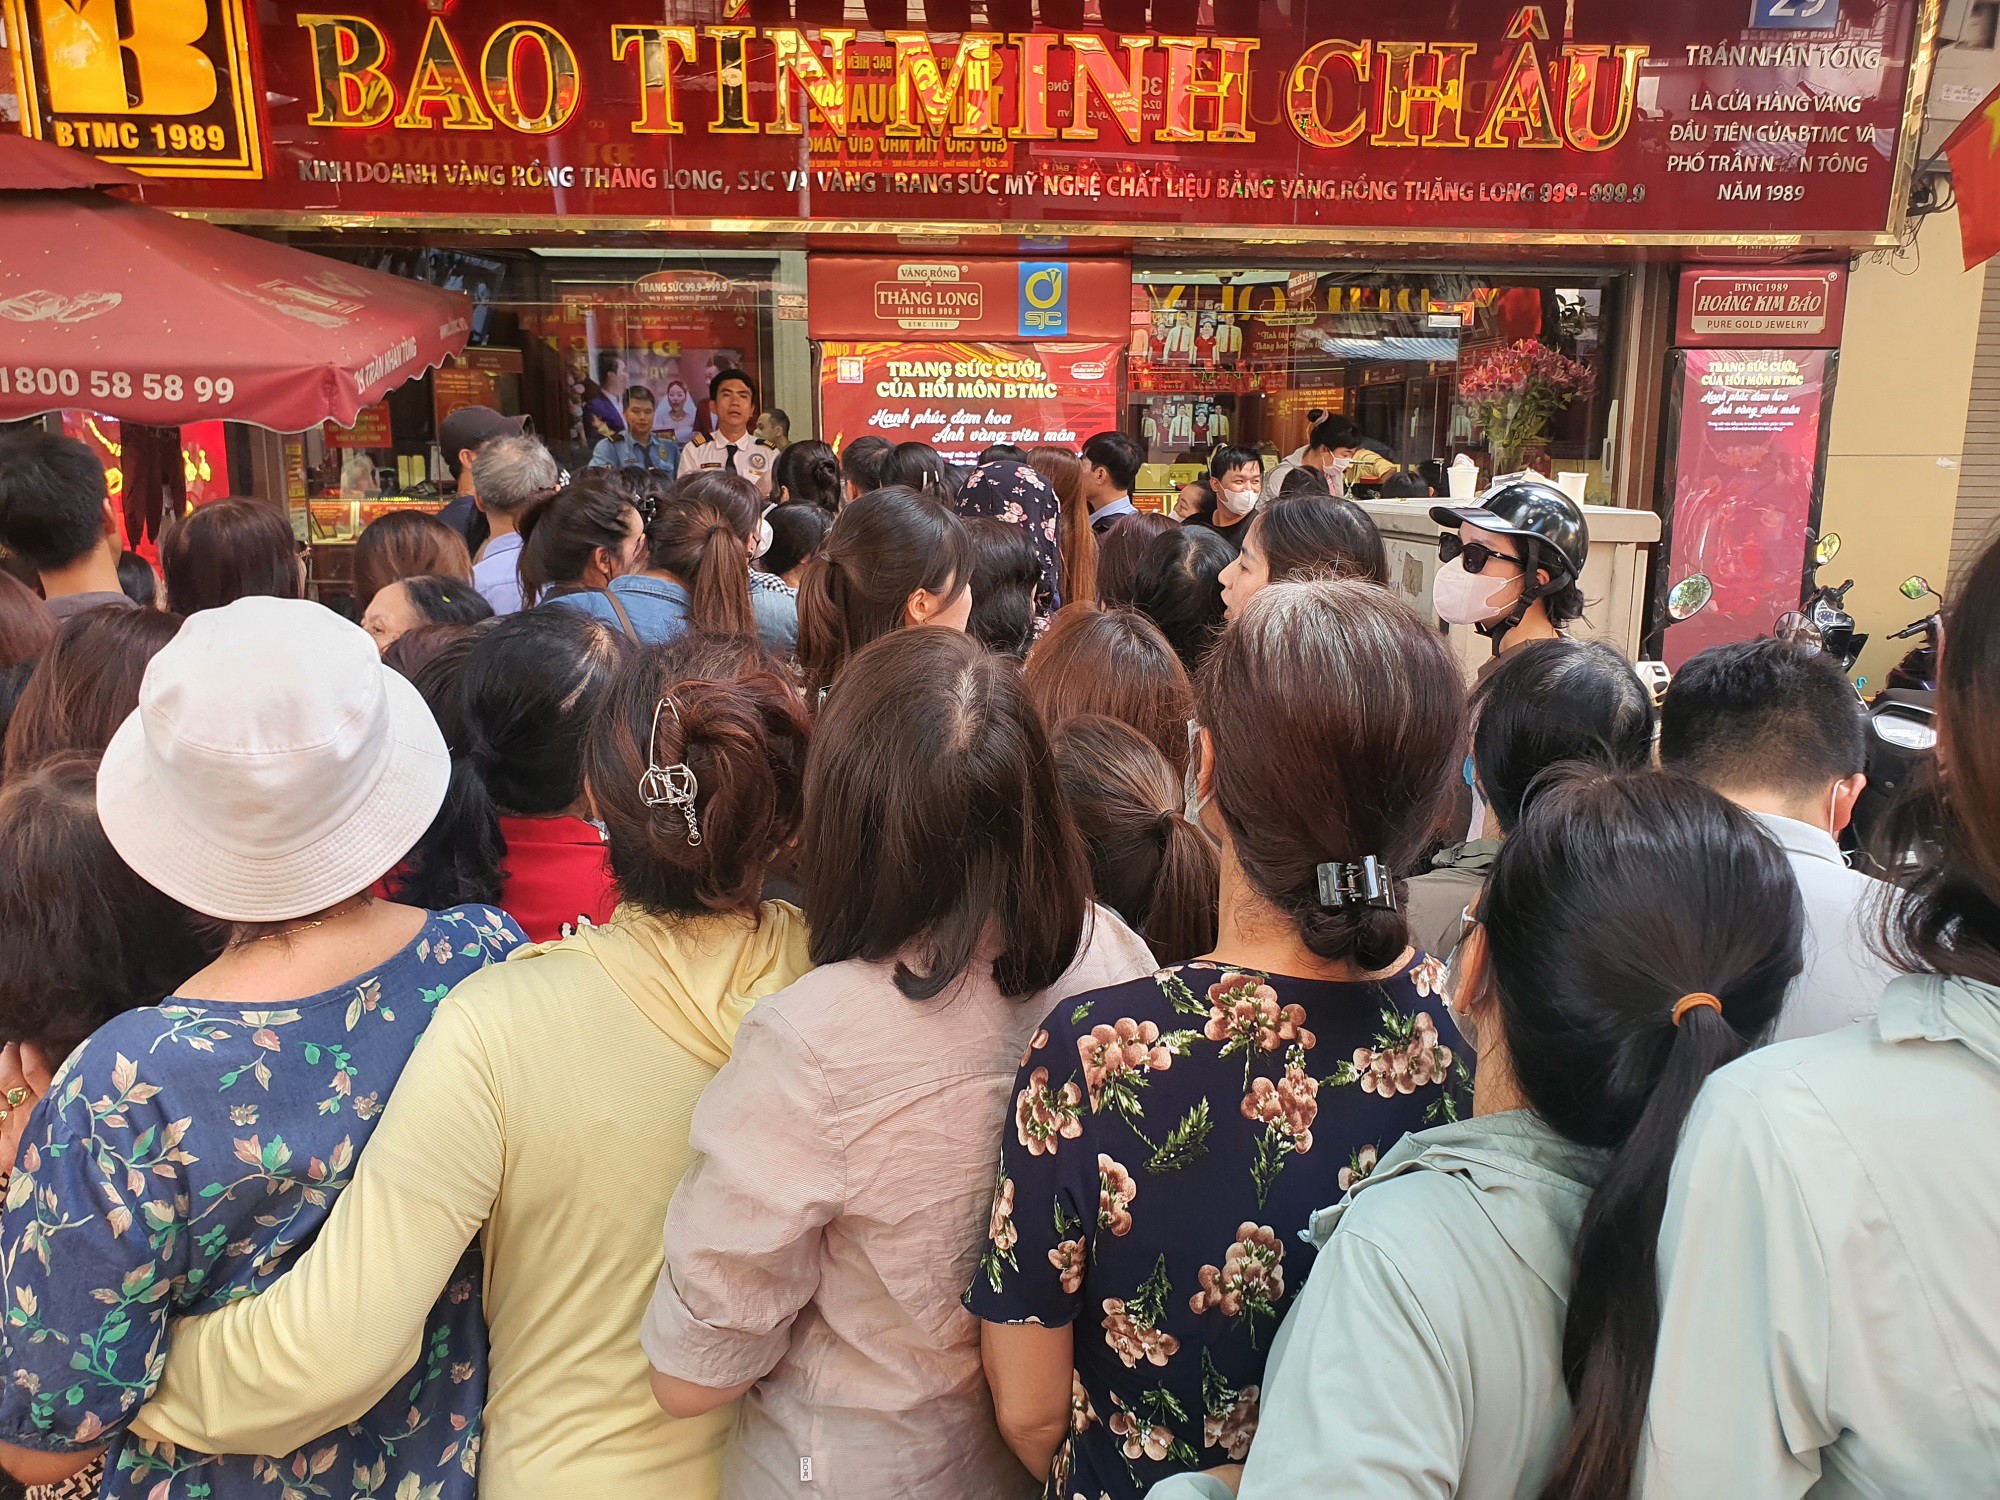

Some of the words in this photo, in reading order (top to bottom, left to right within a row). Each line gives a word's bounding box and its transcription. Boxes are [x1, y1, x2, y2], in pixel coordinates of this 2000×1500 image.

[611, 0, 856, 138] TÍN
[884, 30, 1261, 144] MINH
[1286, 5, 1650, 152] CHÂU
[1691, 91, 1712, 111] LÀ
[1717, 89, 1750, 111] CỬA
[1756, 91, 1809, 112] HÀNG
[54, 121, 139, 149] BTMC
[151, 123, 225, 151] 1989
[1670, 119, 1707, 142] ĐẦU
[1714, 123, 1751, 142] TIÊN
[1756, 121, 1792, 142] CỦA
[1797, 126, 1849, 143] BTMC
[1856, 123, 1876, 143] VÀ
[1667, 150, 1704, 172] PHỐ
[1818, 152, 1868, 173] TÔNG
[299, 160, 353, 182] KINH
[357, 162, 437, 184] DOANH
[444, 160, 505, 186] VÀNG
[580, 163, 656, 189] THĂNG
[663, 169, 731, 195] LONG,
[737, 170, 775, 191] SJC
[817, 167, 876, 193] VÀNG
[883, 172, 953, 195] TRANG
[957, 168, 1000, 194] SỨC
[1005, 170, 1037, 196] MỸ
[1043, 175, 1101, 202] NGHỆ
[1106, 170, 1161, 197] CHẤT
[1166, 175, 1211, 203] LIỆU
[1216, 169, 1275, 199] BẰNG
[1404, 176, 1473, 202] THĂNG
[1480, 182, 1535, 202] LONG
[1717, 181, 1761, 200] NĂM
[1766, 186, 1806, 201] 1989
[901, 267, 928, 278] VÀNG
[639, 282, 667, 293] TRANG
[877, 288, 932, 305] THĂNG
[936, 292, 979, 306] LONG
[1734, 283, 1763, 292] BTMC
[1765, 283, 1788, 292] 1989
[897, 307, 914, 315] FINE
[917, 307, 936, 315] GOLD
[1697, 291, 1752, 312] HOÀNG
[1754, 295, 1784, 312] KIM
[1787, 291, 1822, 312] BẢO
[1024, 311, 1062, 330] SJC
[1707, 320, 1732, 329] PURE
[1735, 320, 1763, 329] GOLD
[1765, 320, 1809, 329] JEWELRY
[886, 361, 953, 379] TRANG
[955, 358, 992, 378] SỨC
[993, 358, 1047, 380] CƯỚI,
[1709, 361, 1745, 373] TRANG
[0, 367, 79, 397] 1800
[90, 370, 132, 399] 58
[142, 373, 184, 402] 58
[194, 376, 235, 404] 99
[876, 379, 917, 399] CỦA
[918, 376, 955, 399] HỒI
[957, 379, 1003, 399] MÔN
[1003, 382, 1057, 399] BTMC
[1773, 375, 1804, 386] BTMC
[910, 408, 947, 429] phúc
[984, 408, 1012, 425] hoa
